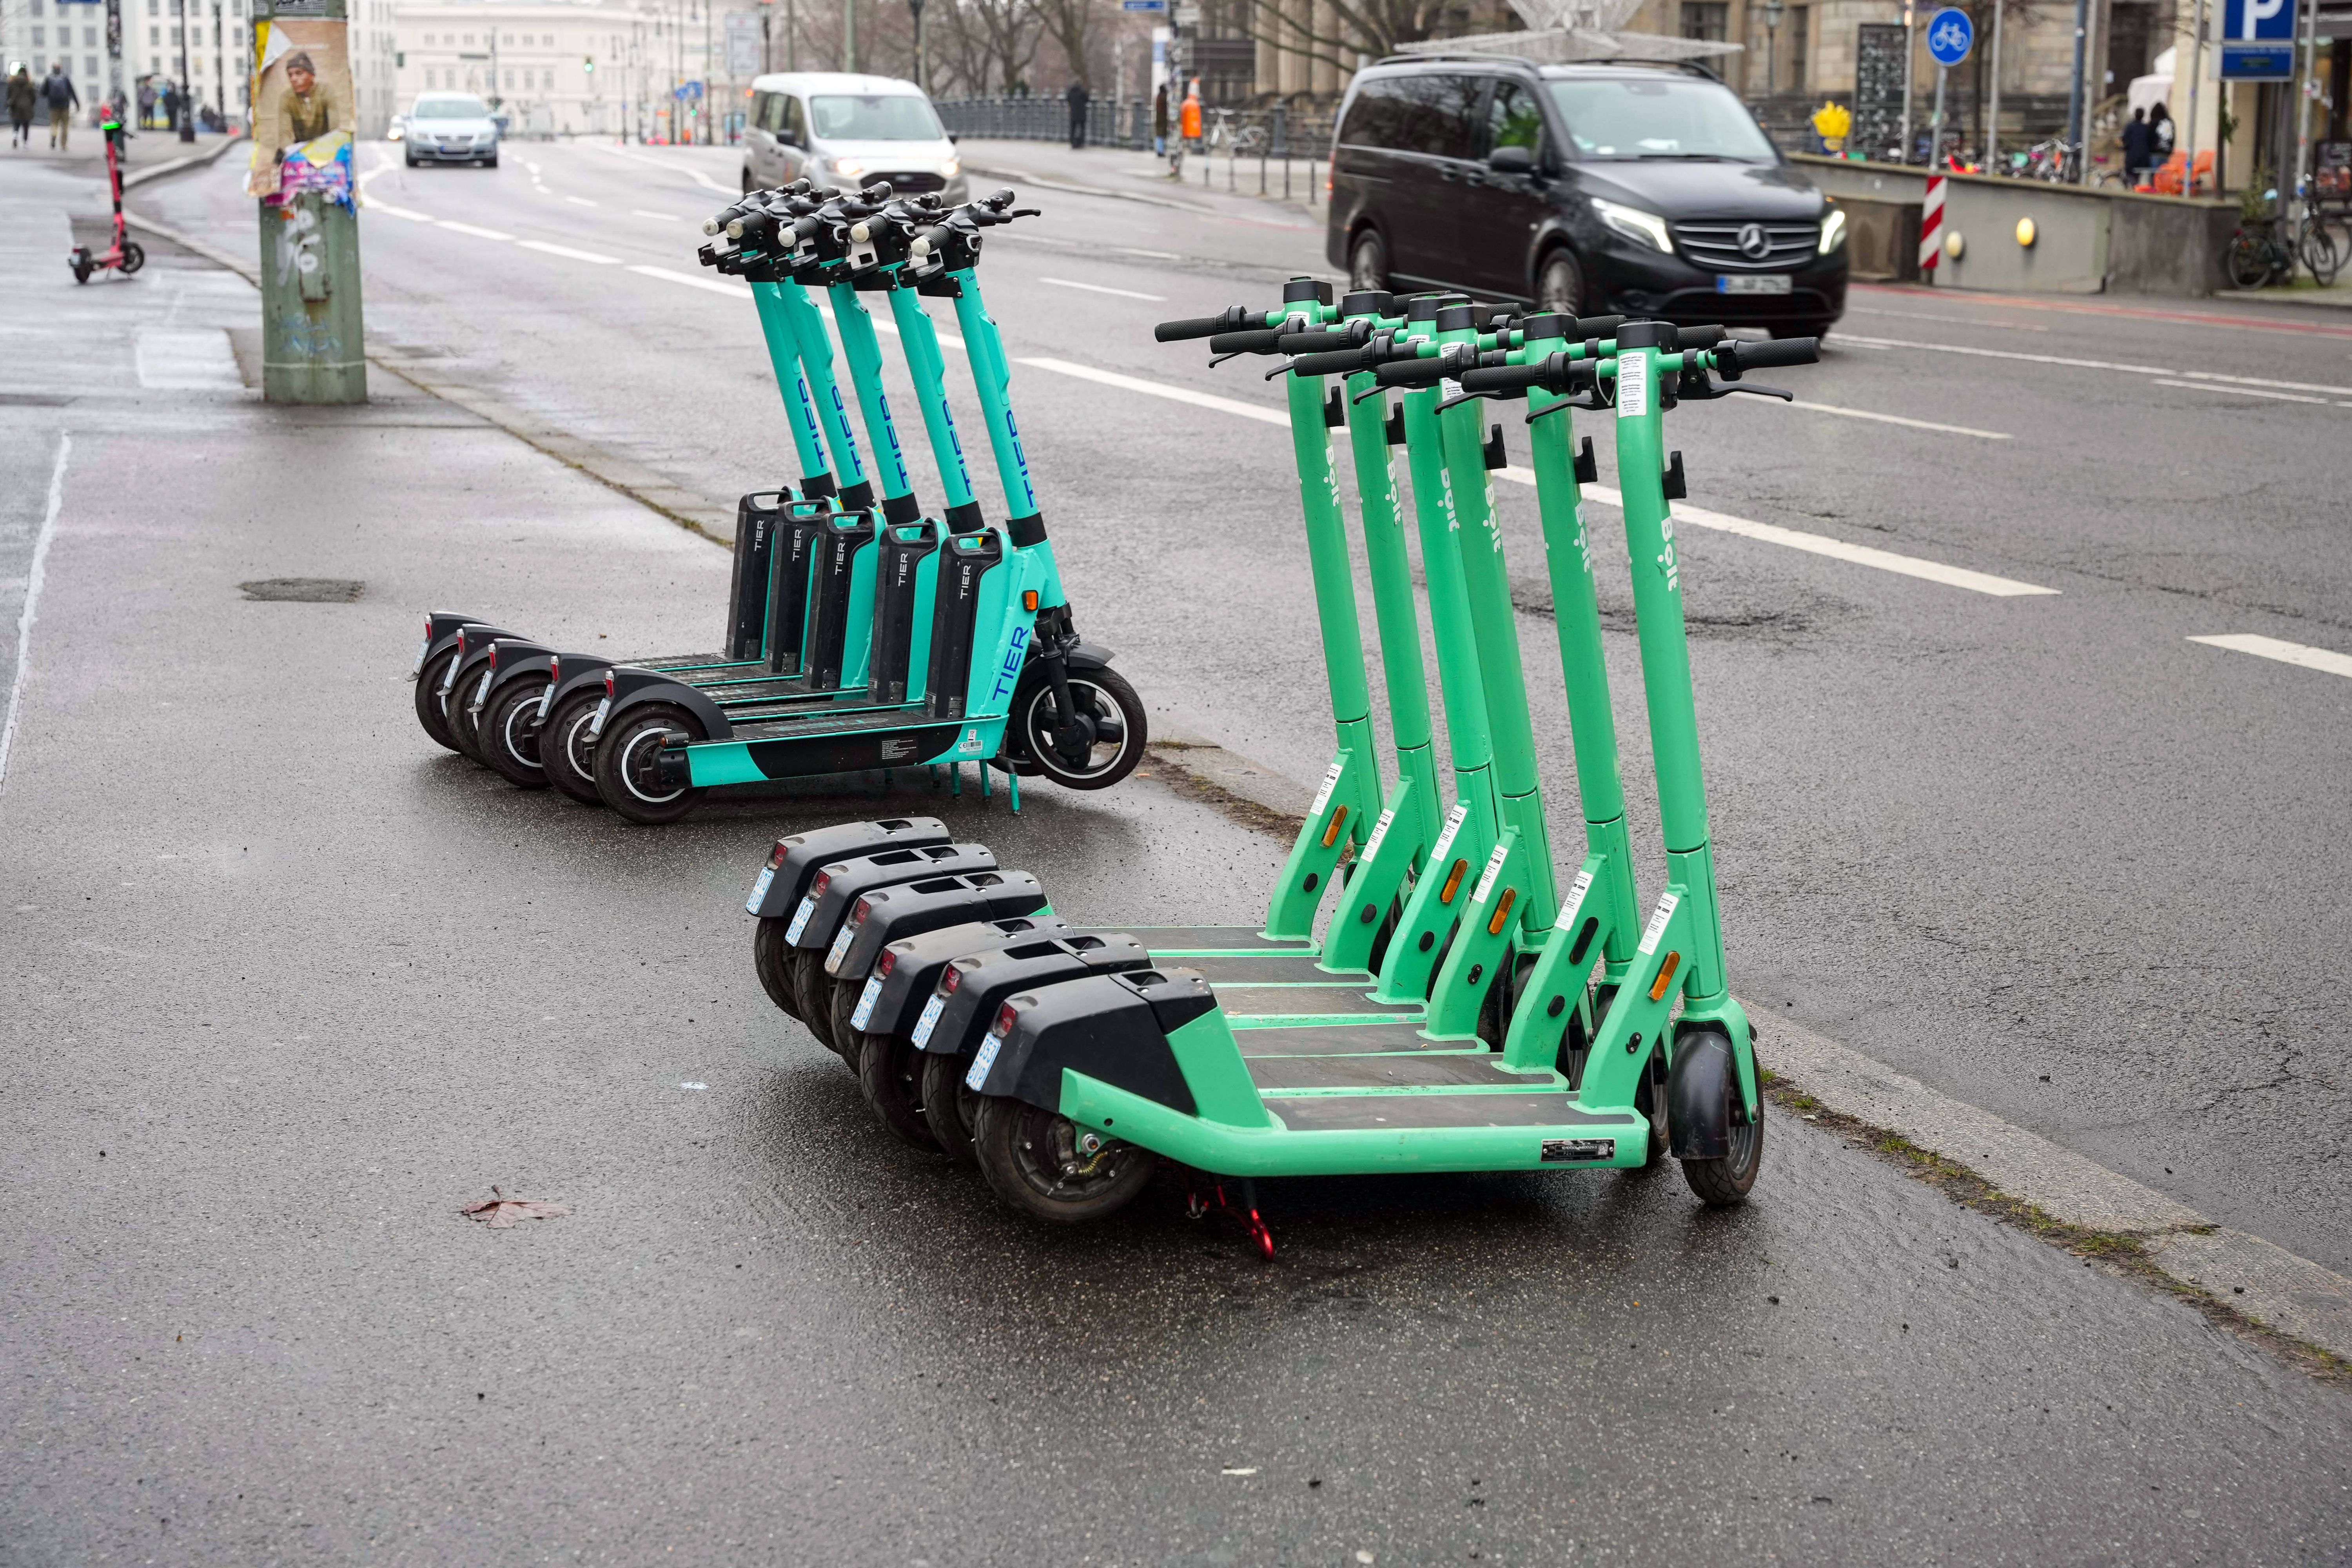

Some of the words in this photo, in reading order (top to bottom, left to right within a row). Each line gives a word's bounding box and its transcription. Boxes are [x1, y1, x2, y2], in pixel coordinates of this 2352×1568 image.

[2243, 0, 2284, 41] P
[1325, 445, 1339, 506] Bolt
[1387, 459, 1401, 525] Bolt
[1485, 483, 1501, 553] Bolt
[755, 520, 764, 551] TIER
[792, 529, 802, 561] TIER
[1575, 500, 1591, 573] Bolt
[835, 542, 845, 575] TIER
[1661, 516, 1678, 591] Bolt
[898, 553, 908, 586] TIER
[960, 565, 971, 599] TIER
[992, 627, 1029, 701] TIER
[748, 890, 761, 909] BVP
[798, 902, 812, 922] 693
[788, 921, 802, 942] BVR
[836, 930, 851, 952] 020
[864, 982, 877, 1004] 406
[854, 1004, 868, 1025] BVP
[924, 1000, 940, 1023] 248
[914, 1022, 930, 1045] BVR
[980, 1038, 996, 1063] 353
[969, 1061, 985, 1085] BVP
